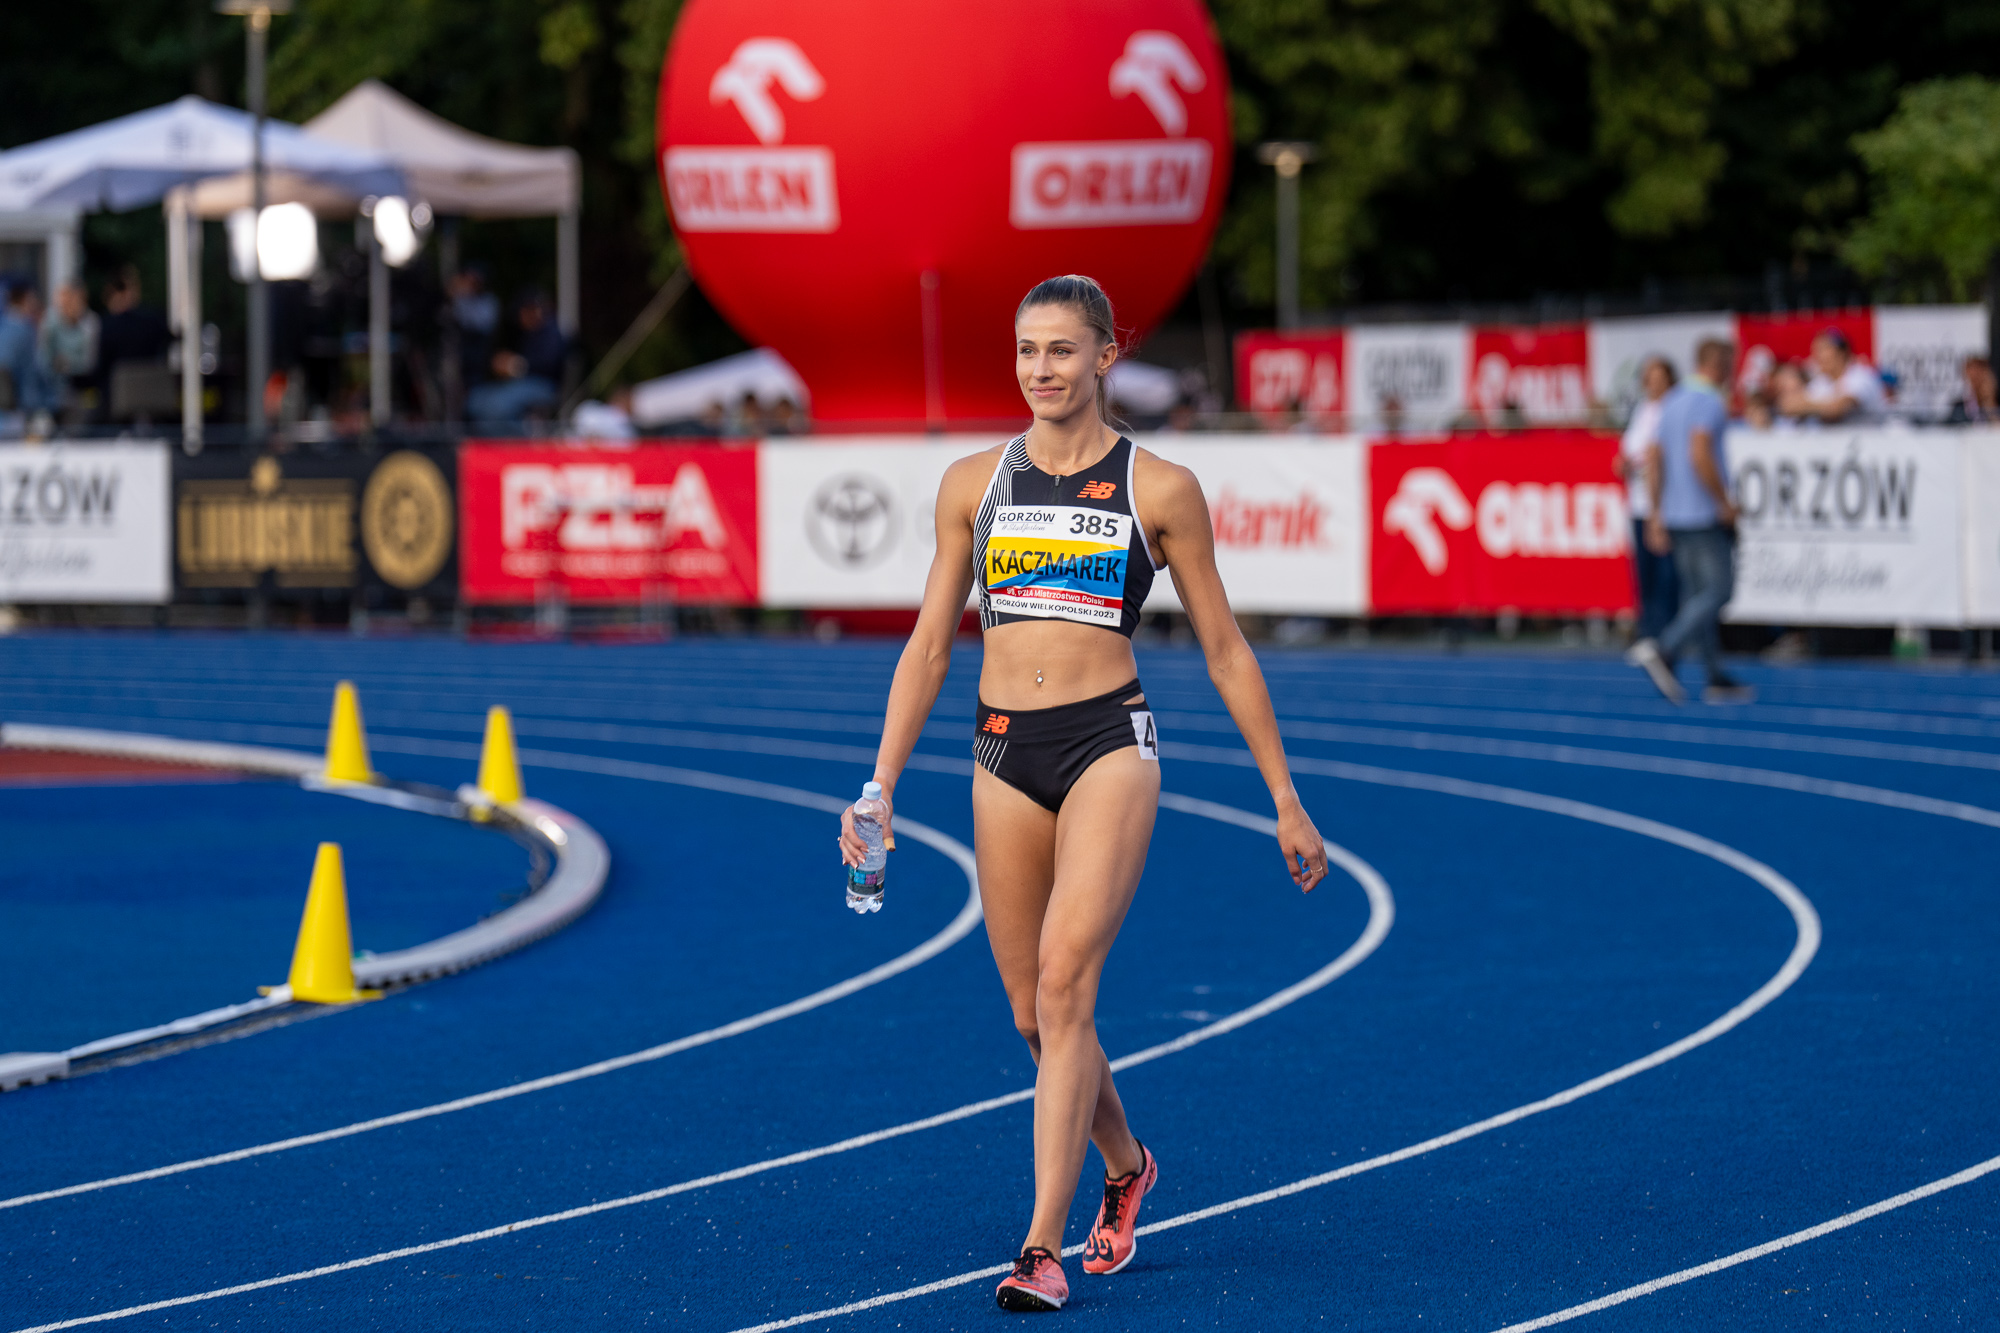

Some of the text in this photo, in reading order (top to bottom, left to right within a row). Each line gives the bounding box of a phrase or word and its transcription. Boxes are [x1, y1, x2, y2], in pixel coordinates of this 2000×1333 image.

[0, 446, 121, 524] ZÓW
[1736, 435, 1917, 525] ORZÓW
[998, 510, 1056, 522] GORZÓW
[1069, 513, 1119, 537] 385
[992, 549, 1121, 583] KACZMAREK
[996, 598, 1115, 619] GORZÓW WIELKOPOLSKI 2023
[1034, 589, 1080, 602] Mistrzostwa
[1081, 595, 1105, 606] Polski
[1143, 715, 1157, 757] 4
